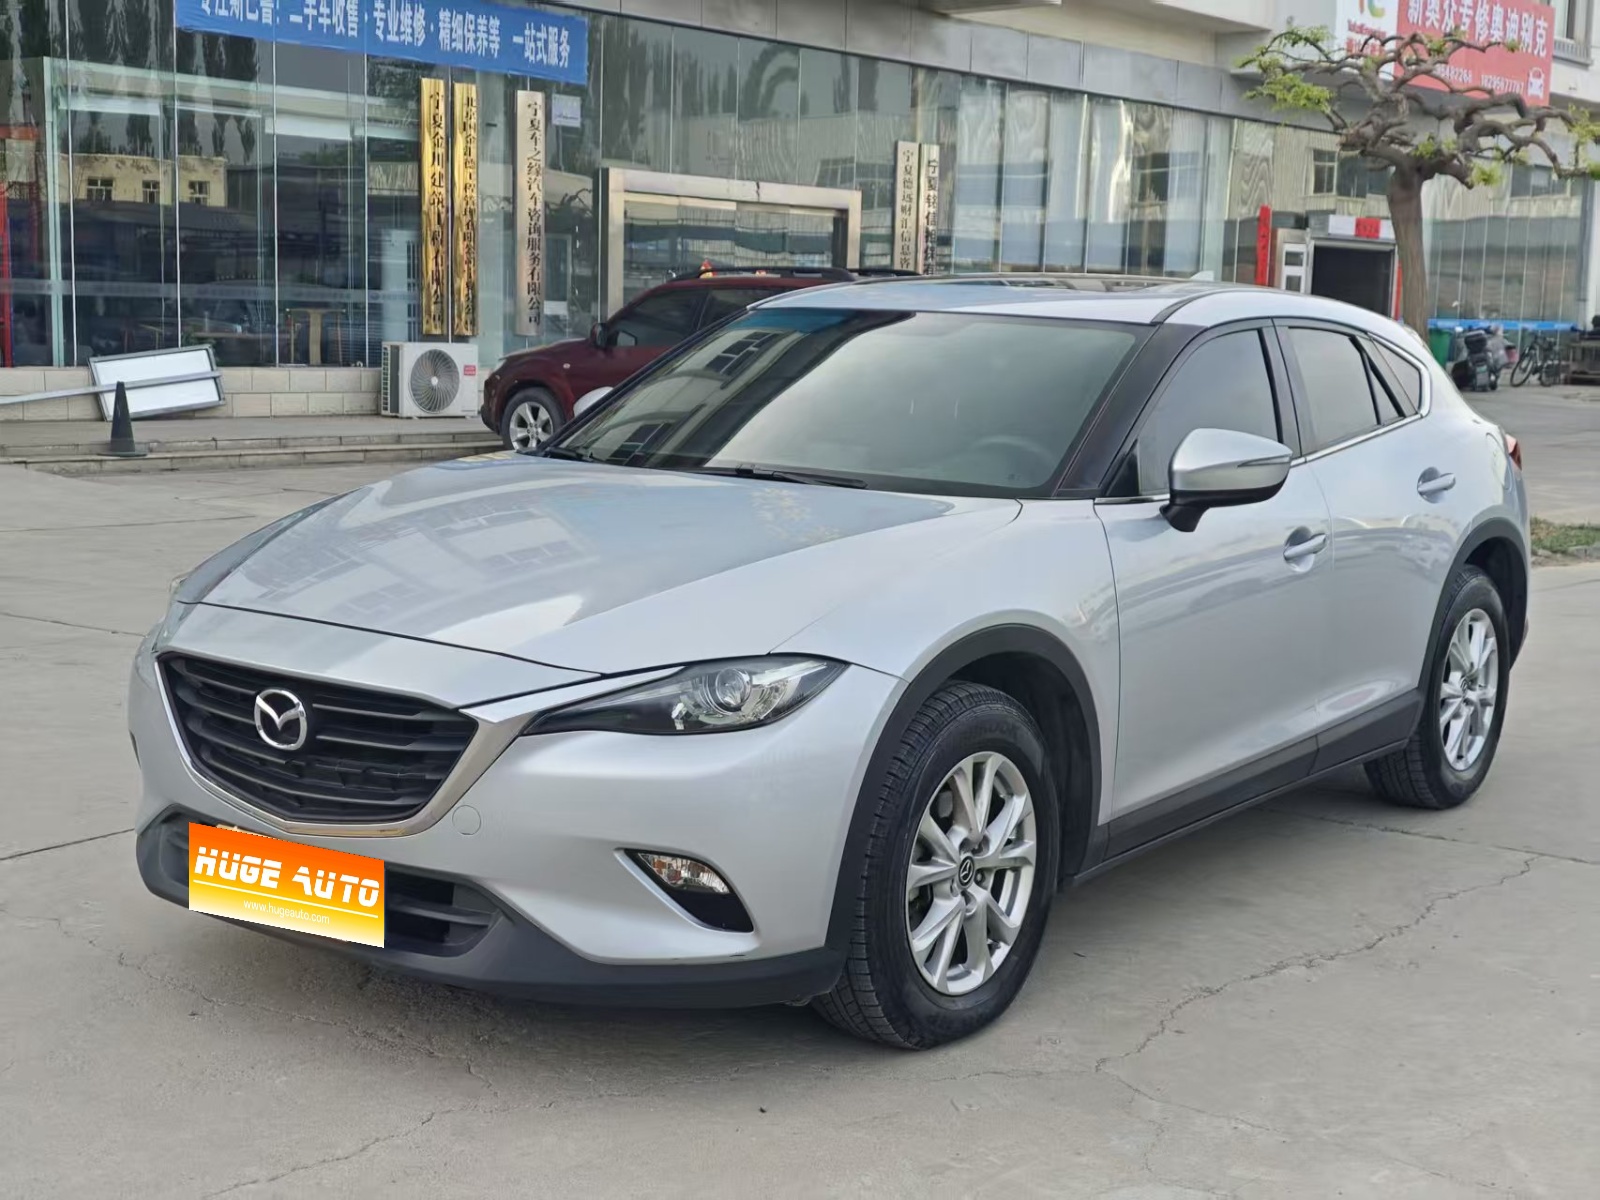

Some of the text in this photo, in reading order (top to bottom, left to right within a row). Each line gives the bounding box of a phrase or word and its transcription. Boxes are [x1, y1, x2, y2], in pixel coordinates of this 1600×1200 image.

[512, 21, 571, 69] 一站式服务
[527, 101, 543, 326] 宁夏车之缘汽车咨询服务有限公司
